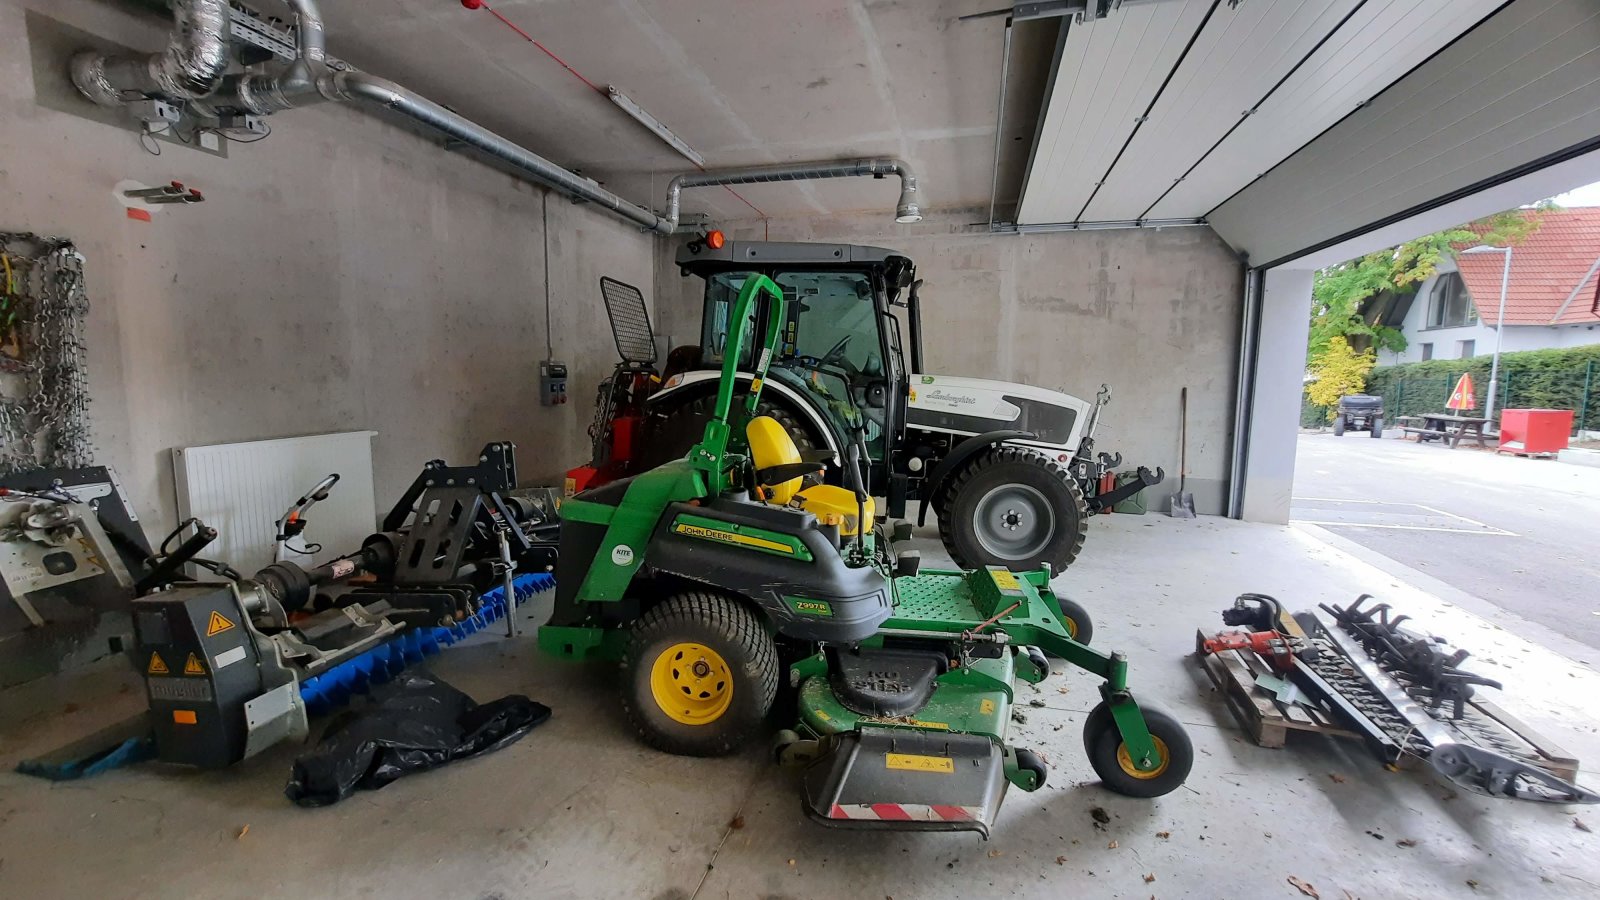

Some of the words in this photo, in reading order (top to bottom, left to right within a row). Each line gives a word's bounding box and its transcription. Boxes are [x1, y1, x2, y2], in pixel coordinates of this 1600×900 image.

[926, 389, 976, 405] Lamborghini
[681, 525, 705, 536] JOHN
[705, 529, 733, 541] DEERE
[616, 549, 631, 557] KITE
[796, 601, 826, 610] Z997R
